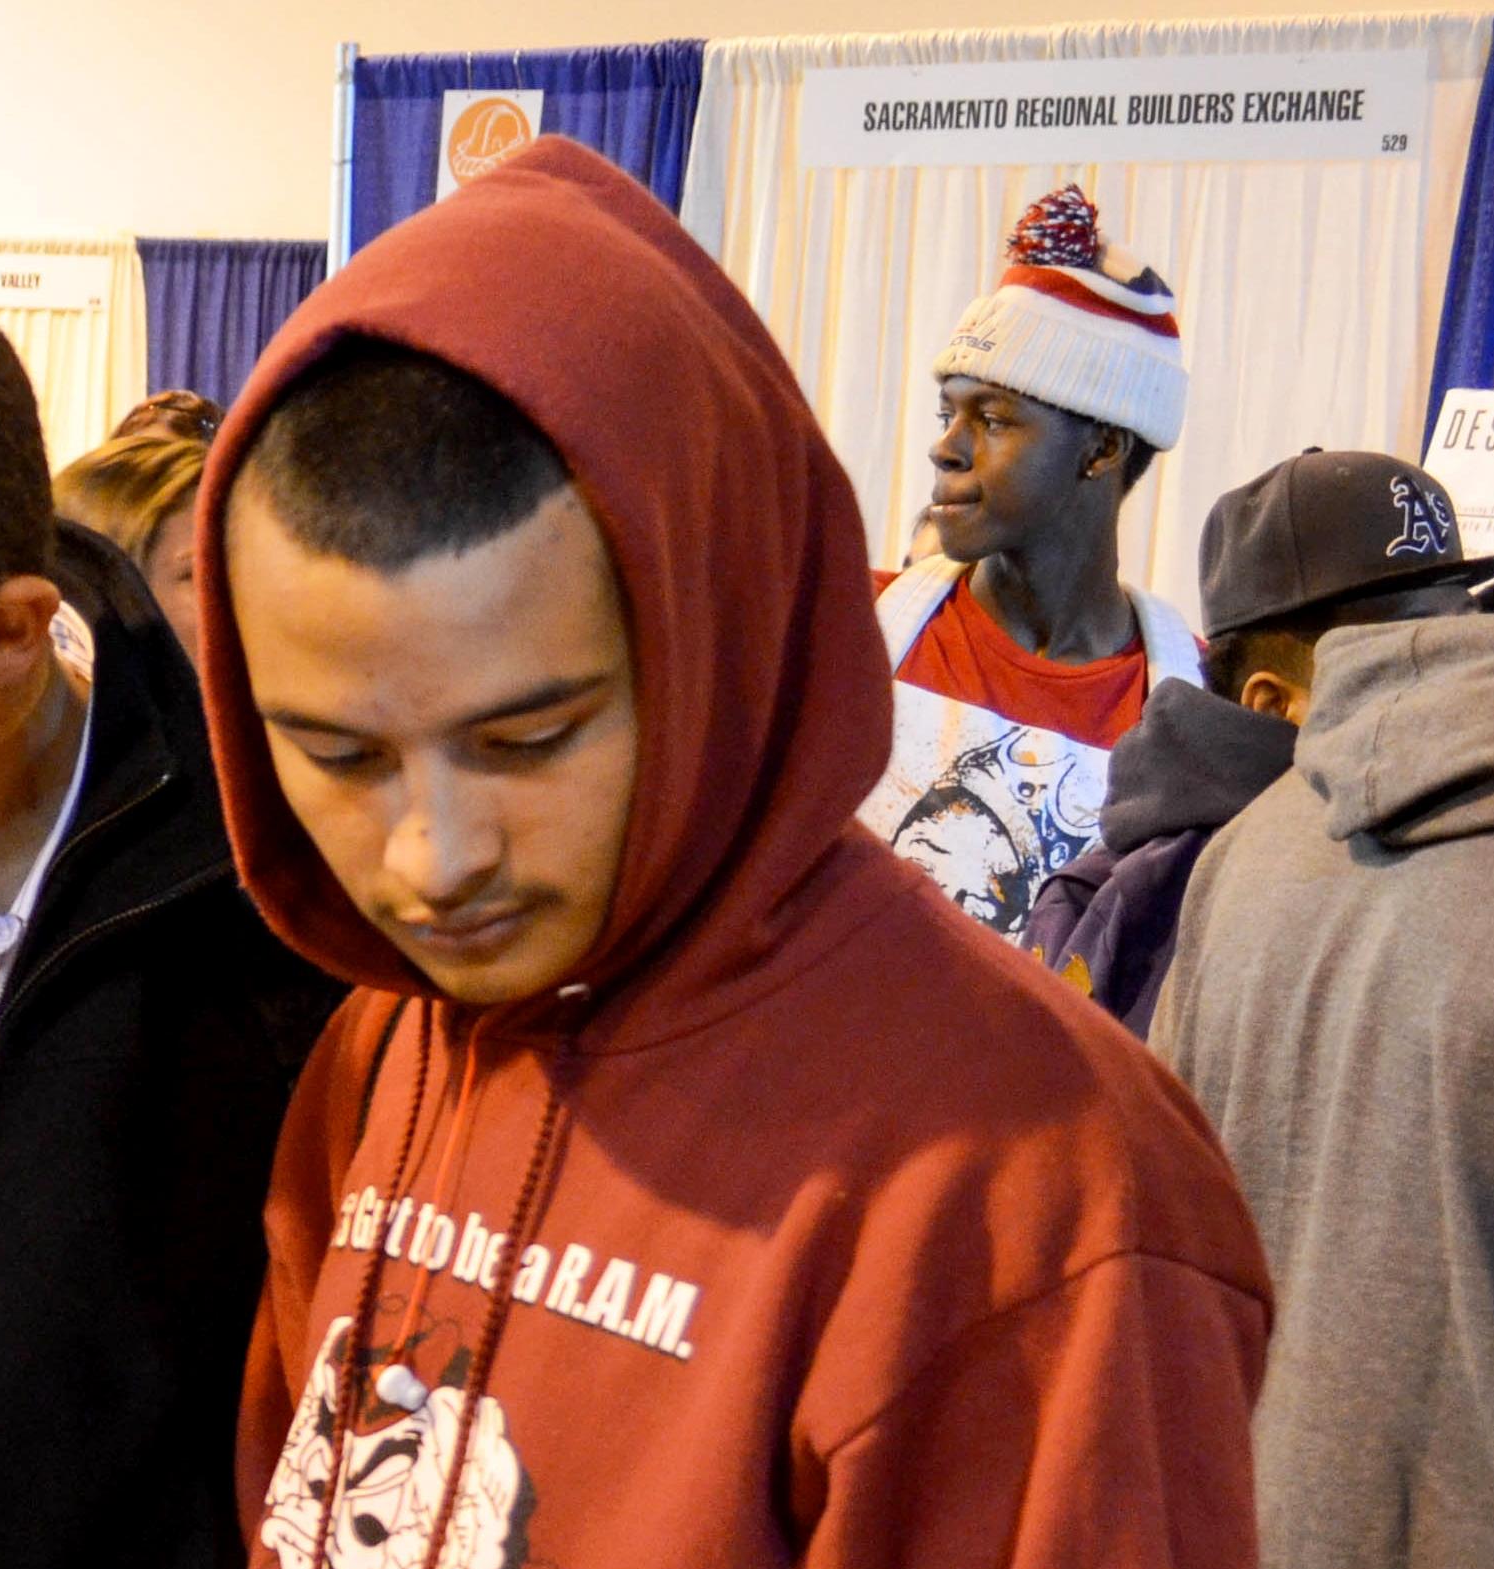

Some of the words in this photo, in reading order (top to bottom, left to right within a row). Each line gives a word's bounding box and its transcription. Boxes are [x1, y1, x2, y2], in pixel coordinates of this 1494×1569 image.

[863, 97, 1008, 132] SACRAMENTO
[1015, 95, 1118, 128] REGIONAL
[1127, 91, 1235, 125] BUILDERS
[1242, 88, 1365, 124] EXCHANGE
[1381, 133, 1408, 152] 529
[0, 271, 40, 289] VALLEY
[407, 1202, 456, 1271] to
[452, 1211, 510, 1291] be
[512, 1243, 551, 1304] a
[544, 1242, 700, 1361] R.A.M.
